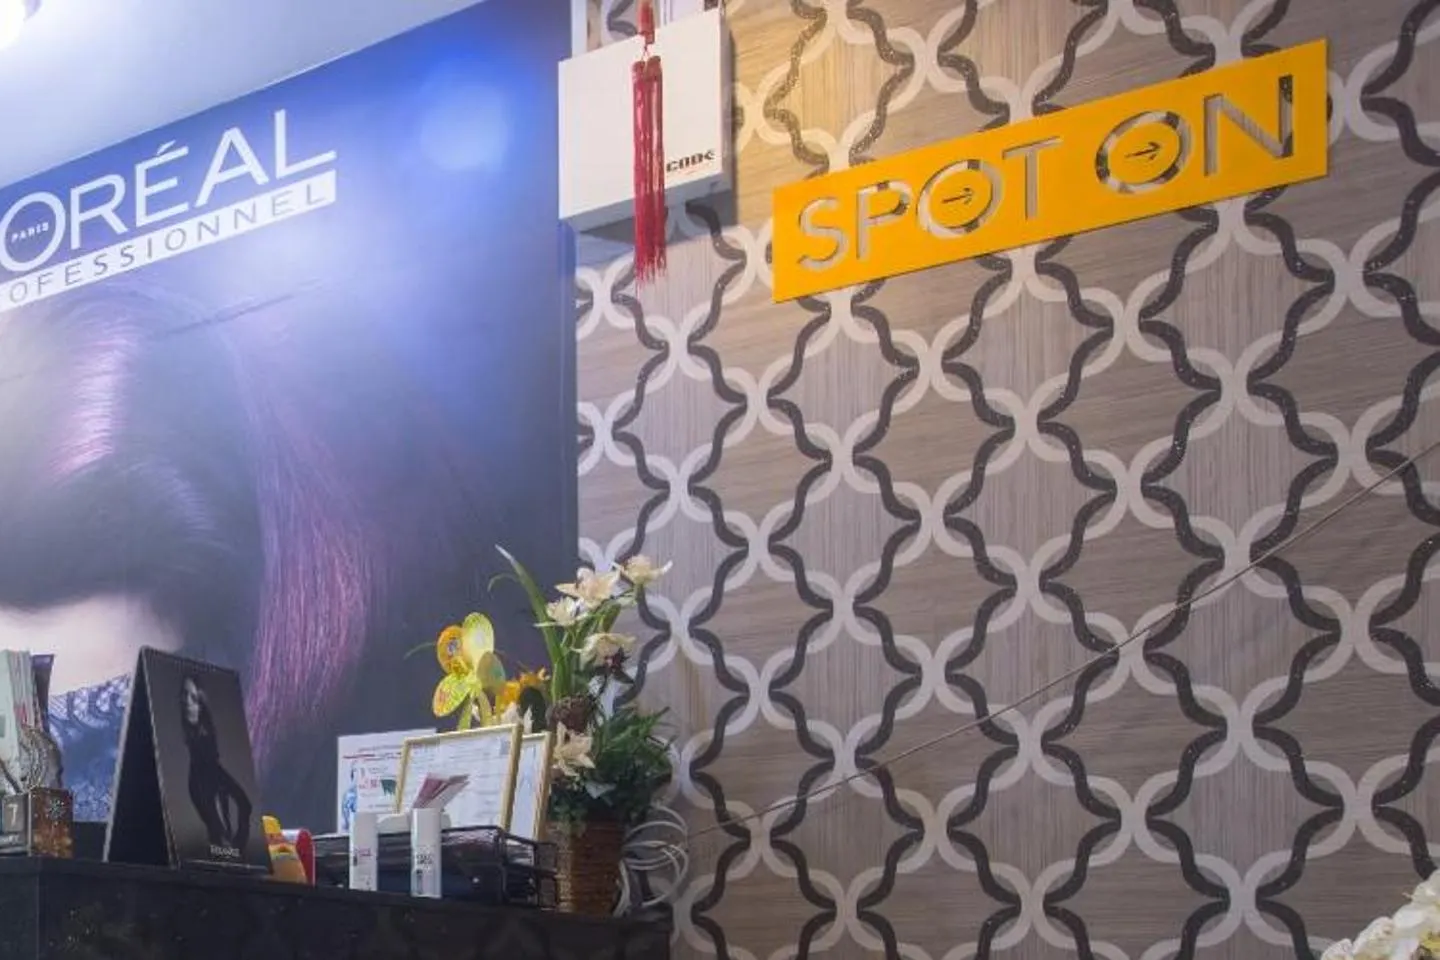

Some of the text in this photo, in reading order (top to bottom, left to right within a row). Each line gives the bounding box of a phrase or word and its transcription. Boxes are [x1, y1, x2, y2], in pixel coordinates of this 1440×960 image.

[666, 150, 715, 172] CODE
[797, 74, 1294, 273] SPOT ON
[10, 221, 50, 244] PARIS
